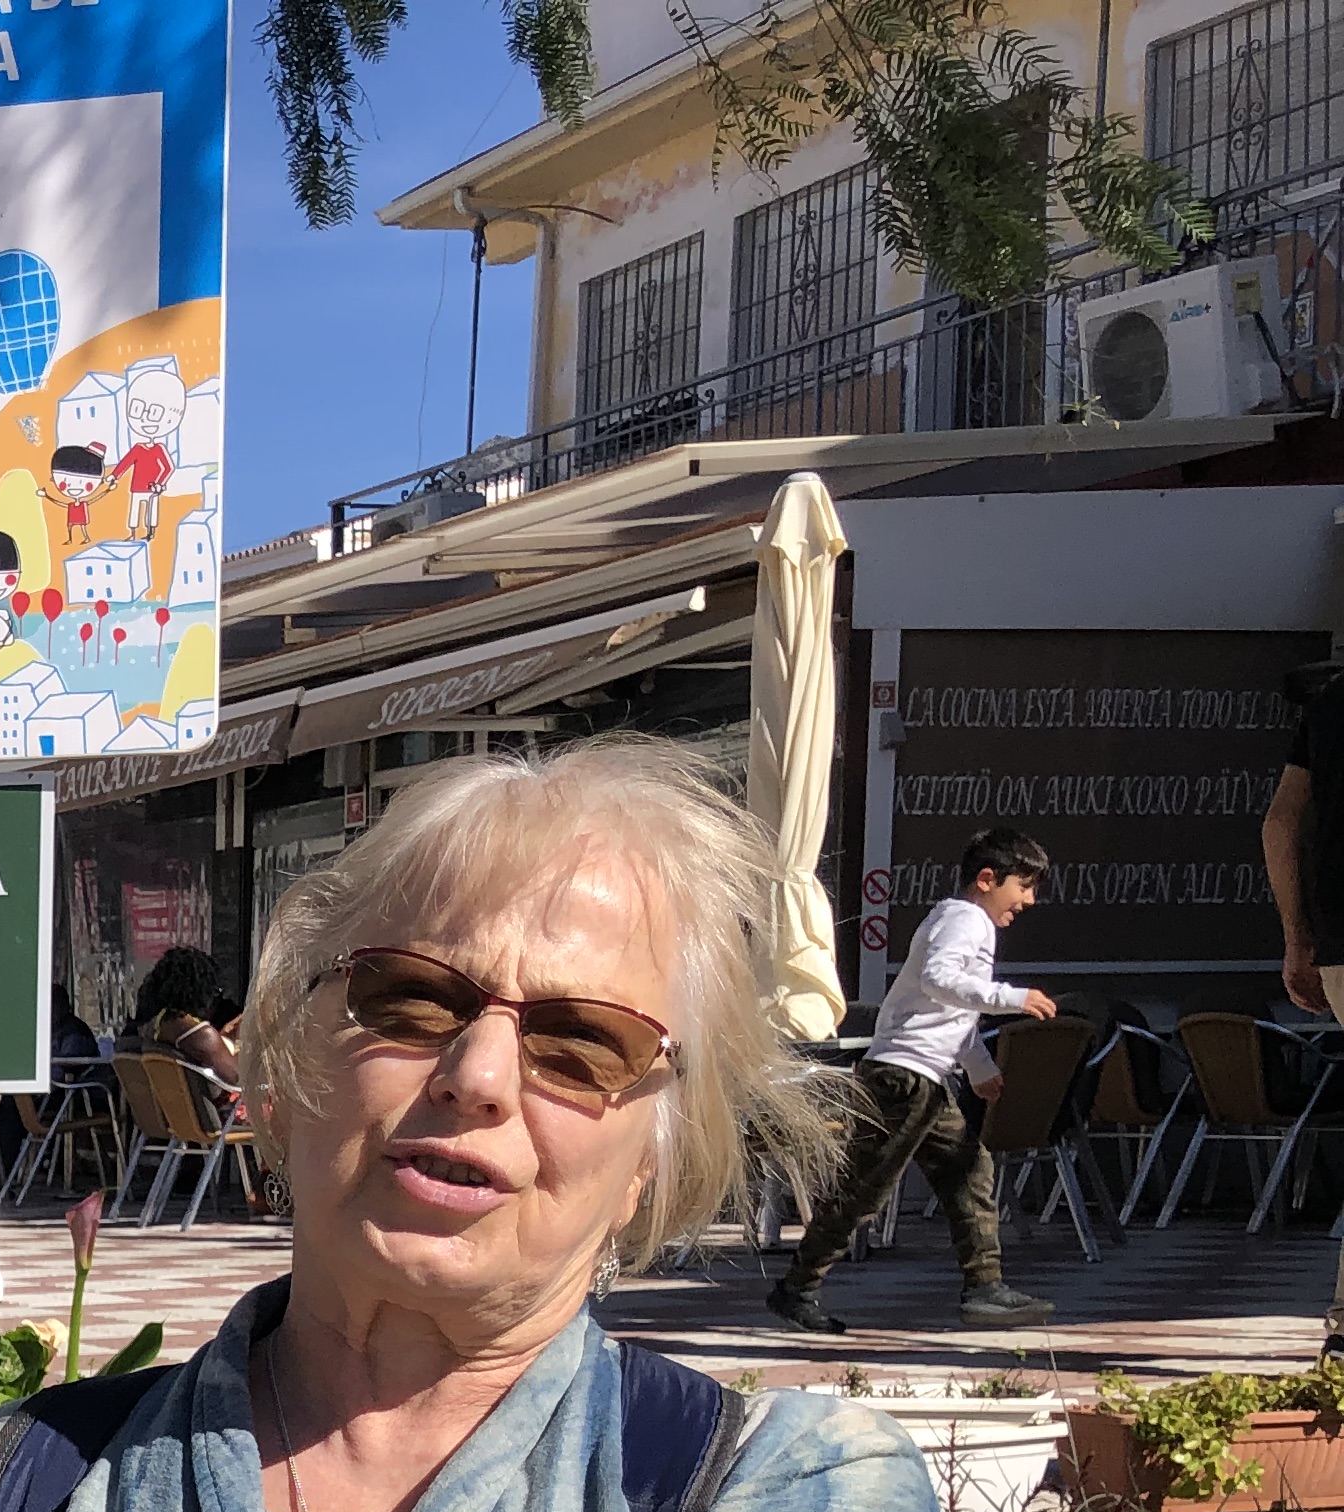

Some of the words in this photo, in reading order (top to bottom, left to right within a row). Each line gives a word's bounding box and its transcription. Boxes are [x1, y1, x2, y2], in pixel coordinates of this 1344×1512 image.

[904, 687, 935, 727] LA
[939, 687, 1017, 728] COCINA
[1080, 683, 1172, 729] ABIERTA
[1178, 685, 1233, 729] TODO
[1236, 689, 1262, 730] EL
[996, 775, 1038, 816] ON
[1039, 775, 1114, 816] AUKI
[1116, 775, 1189, 816] KOKO
[1105, 862, 1178, 905] OPEN
[1181, 862, 1230, 905] ALL
